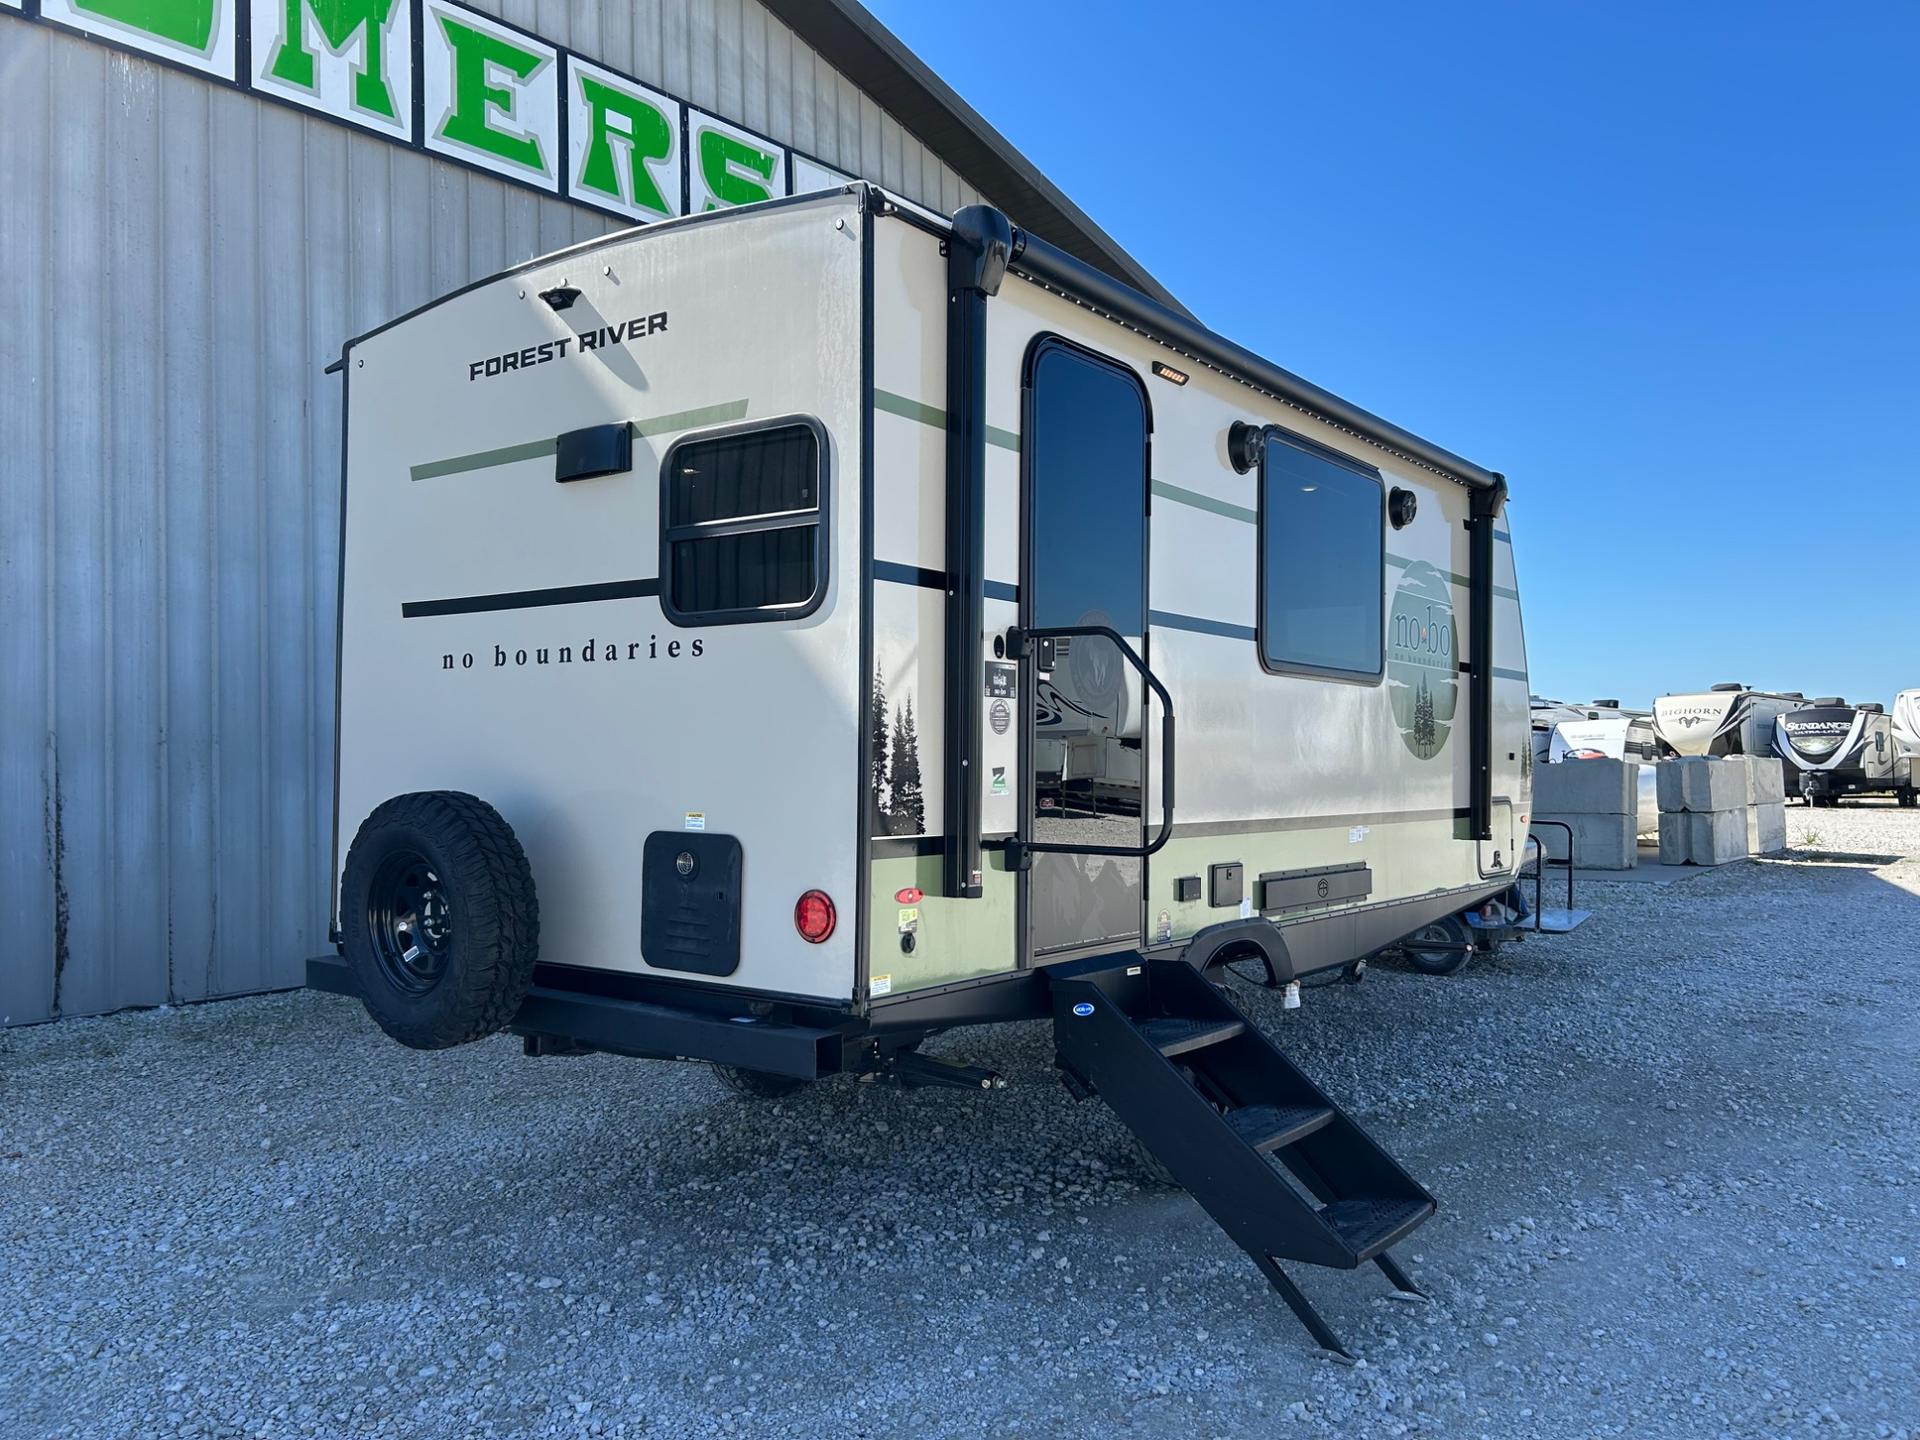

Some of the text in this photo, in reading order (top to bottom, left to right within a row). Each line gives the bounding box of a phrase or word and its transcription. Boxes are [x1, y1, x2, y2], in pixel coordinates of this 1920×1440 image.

[469, 311, 668, 381] FOREST RIVER
[442, 634, 704, 669] no boundaries
[1661, 707, 1722, 716] BIGHORN
[1785, 721, 1852, 732] SUNDANCE
